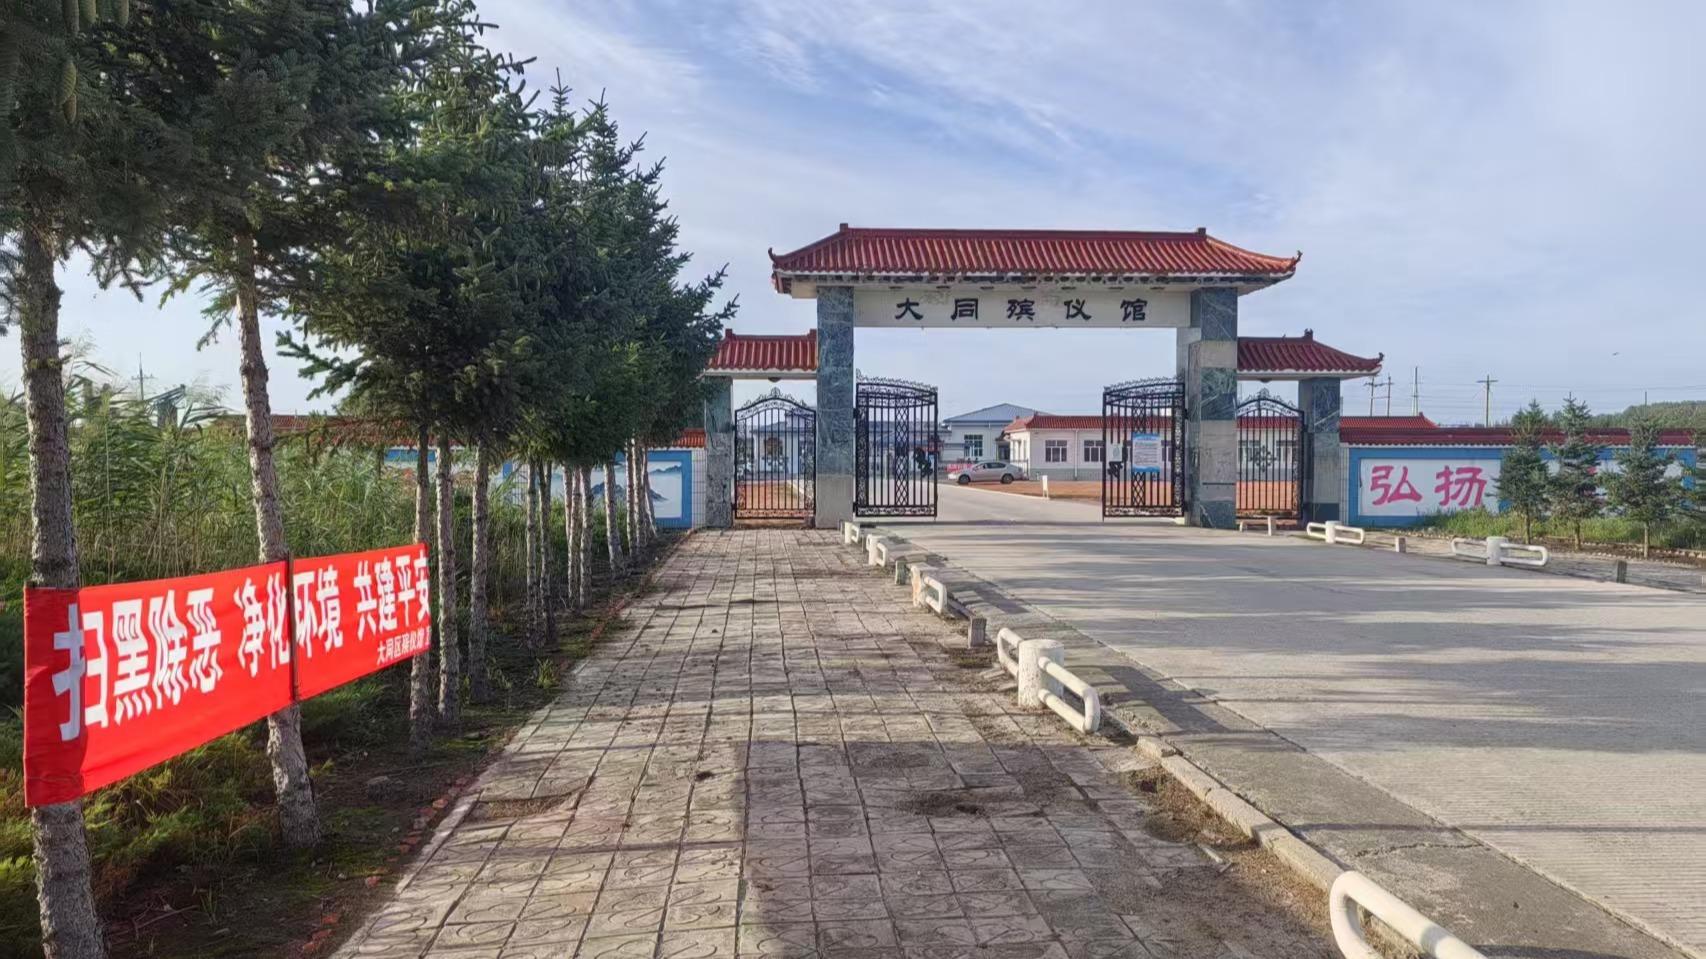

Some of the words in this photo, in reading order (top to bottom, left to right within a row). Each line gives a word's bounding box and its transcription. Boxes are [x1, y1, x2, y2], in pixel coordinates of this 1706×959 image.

[895, 298, 1148, 321] 大同殡仪馆
[1370, 465, 1487, 507] 弘扬
[52, 588, 223, 741] 扫黑除恶
[234, 565, 343, 677] 净化环境
[354, 549, 430, 640] 共建平安
